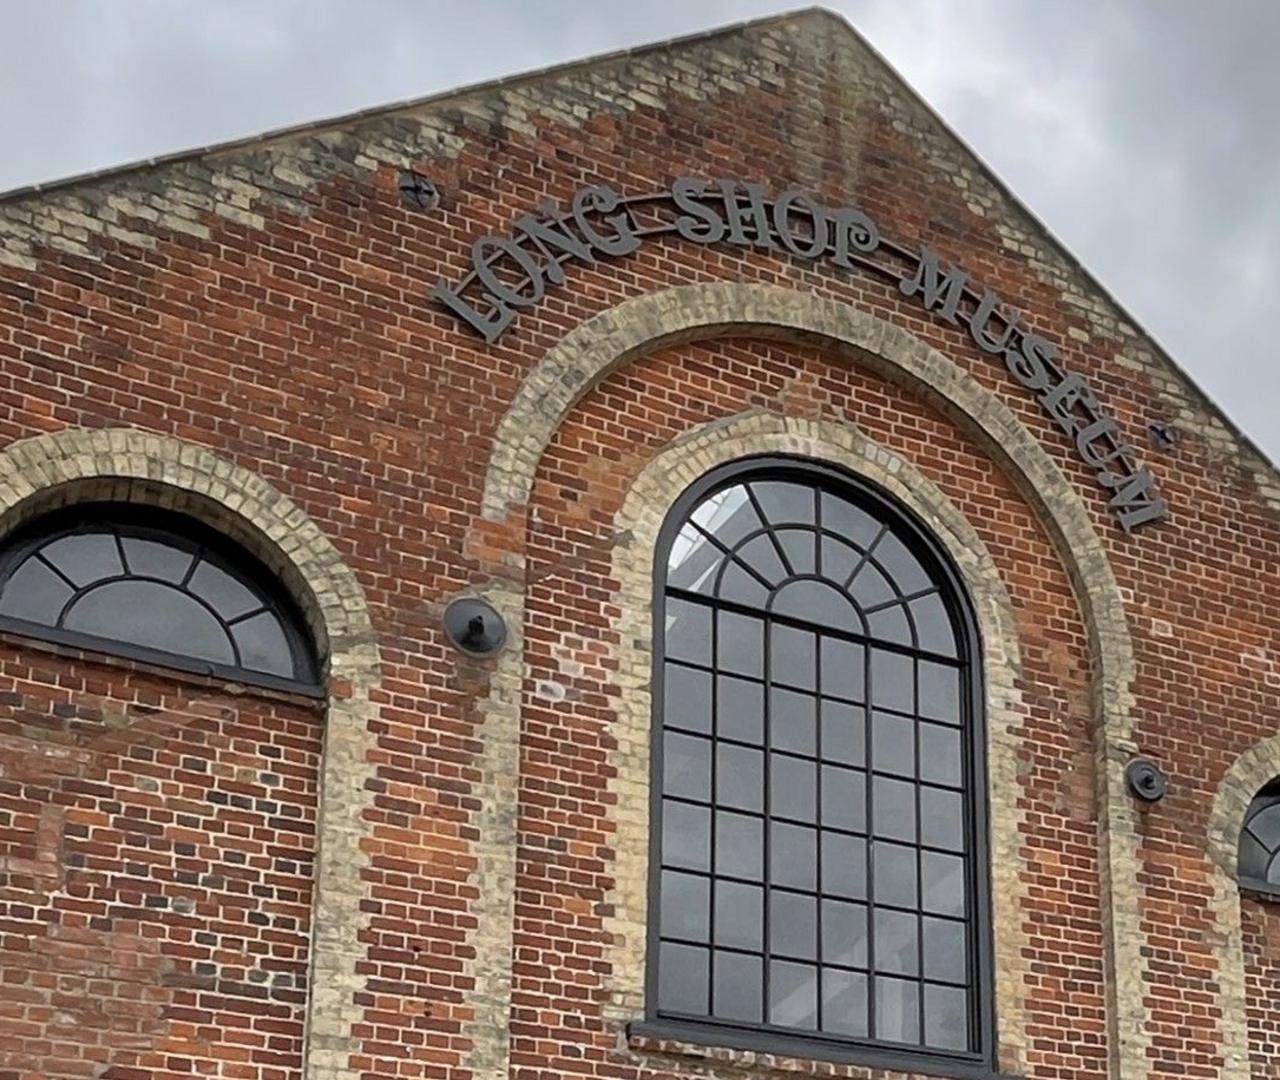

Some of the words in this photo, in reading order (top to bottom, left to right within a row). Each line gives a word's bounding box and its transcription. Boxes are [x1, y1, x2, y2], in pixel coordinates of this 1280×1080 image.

[429, 185, 642, 344] LONG
[672, 176, 880, 269] SHOP
[899, 247, 1168, 534] MUSEUM
